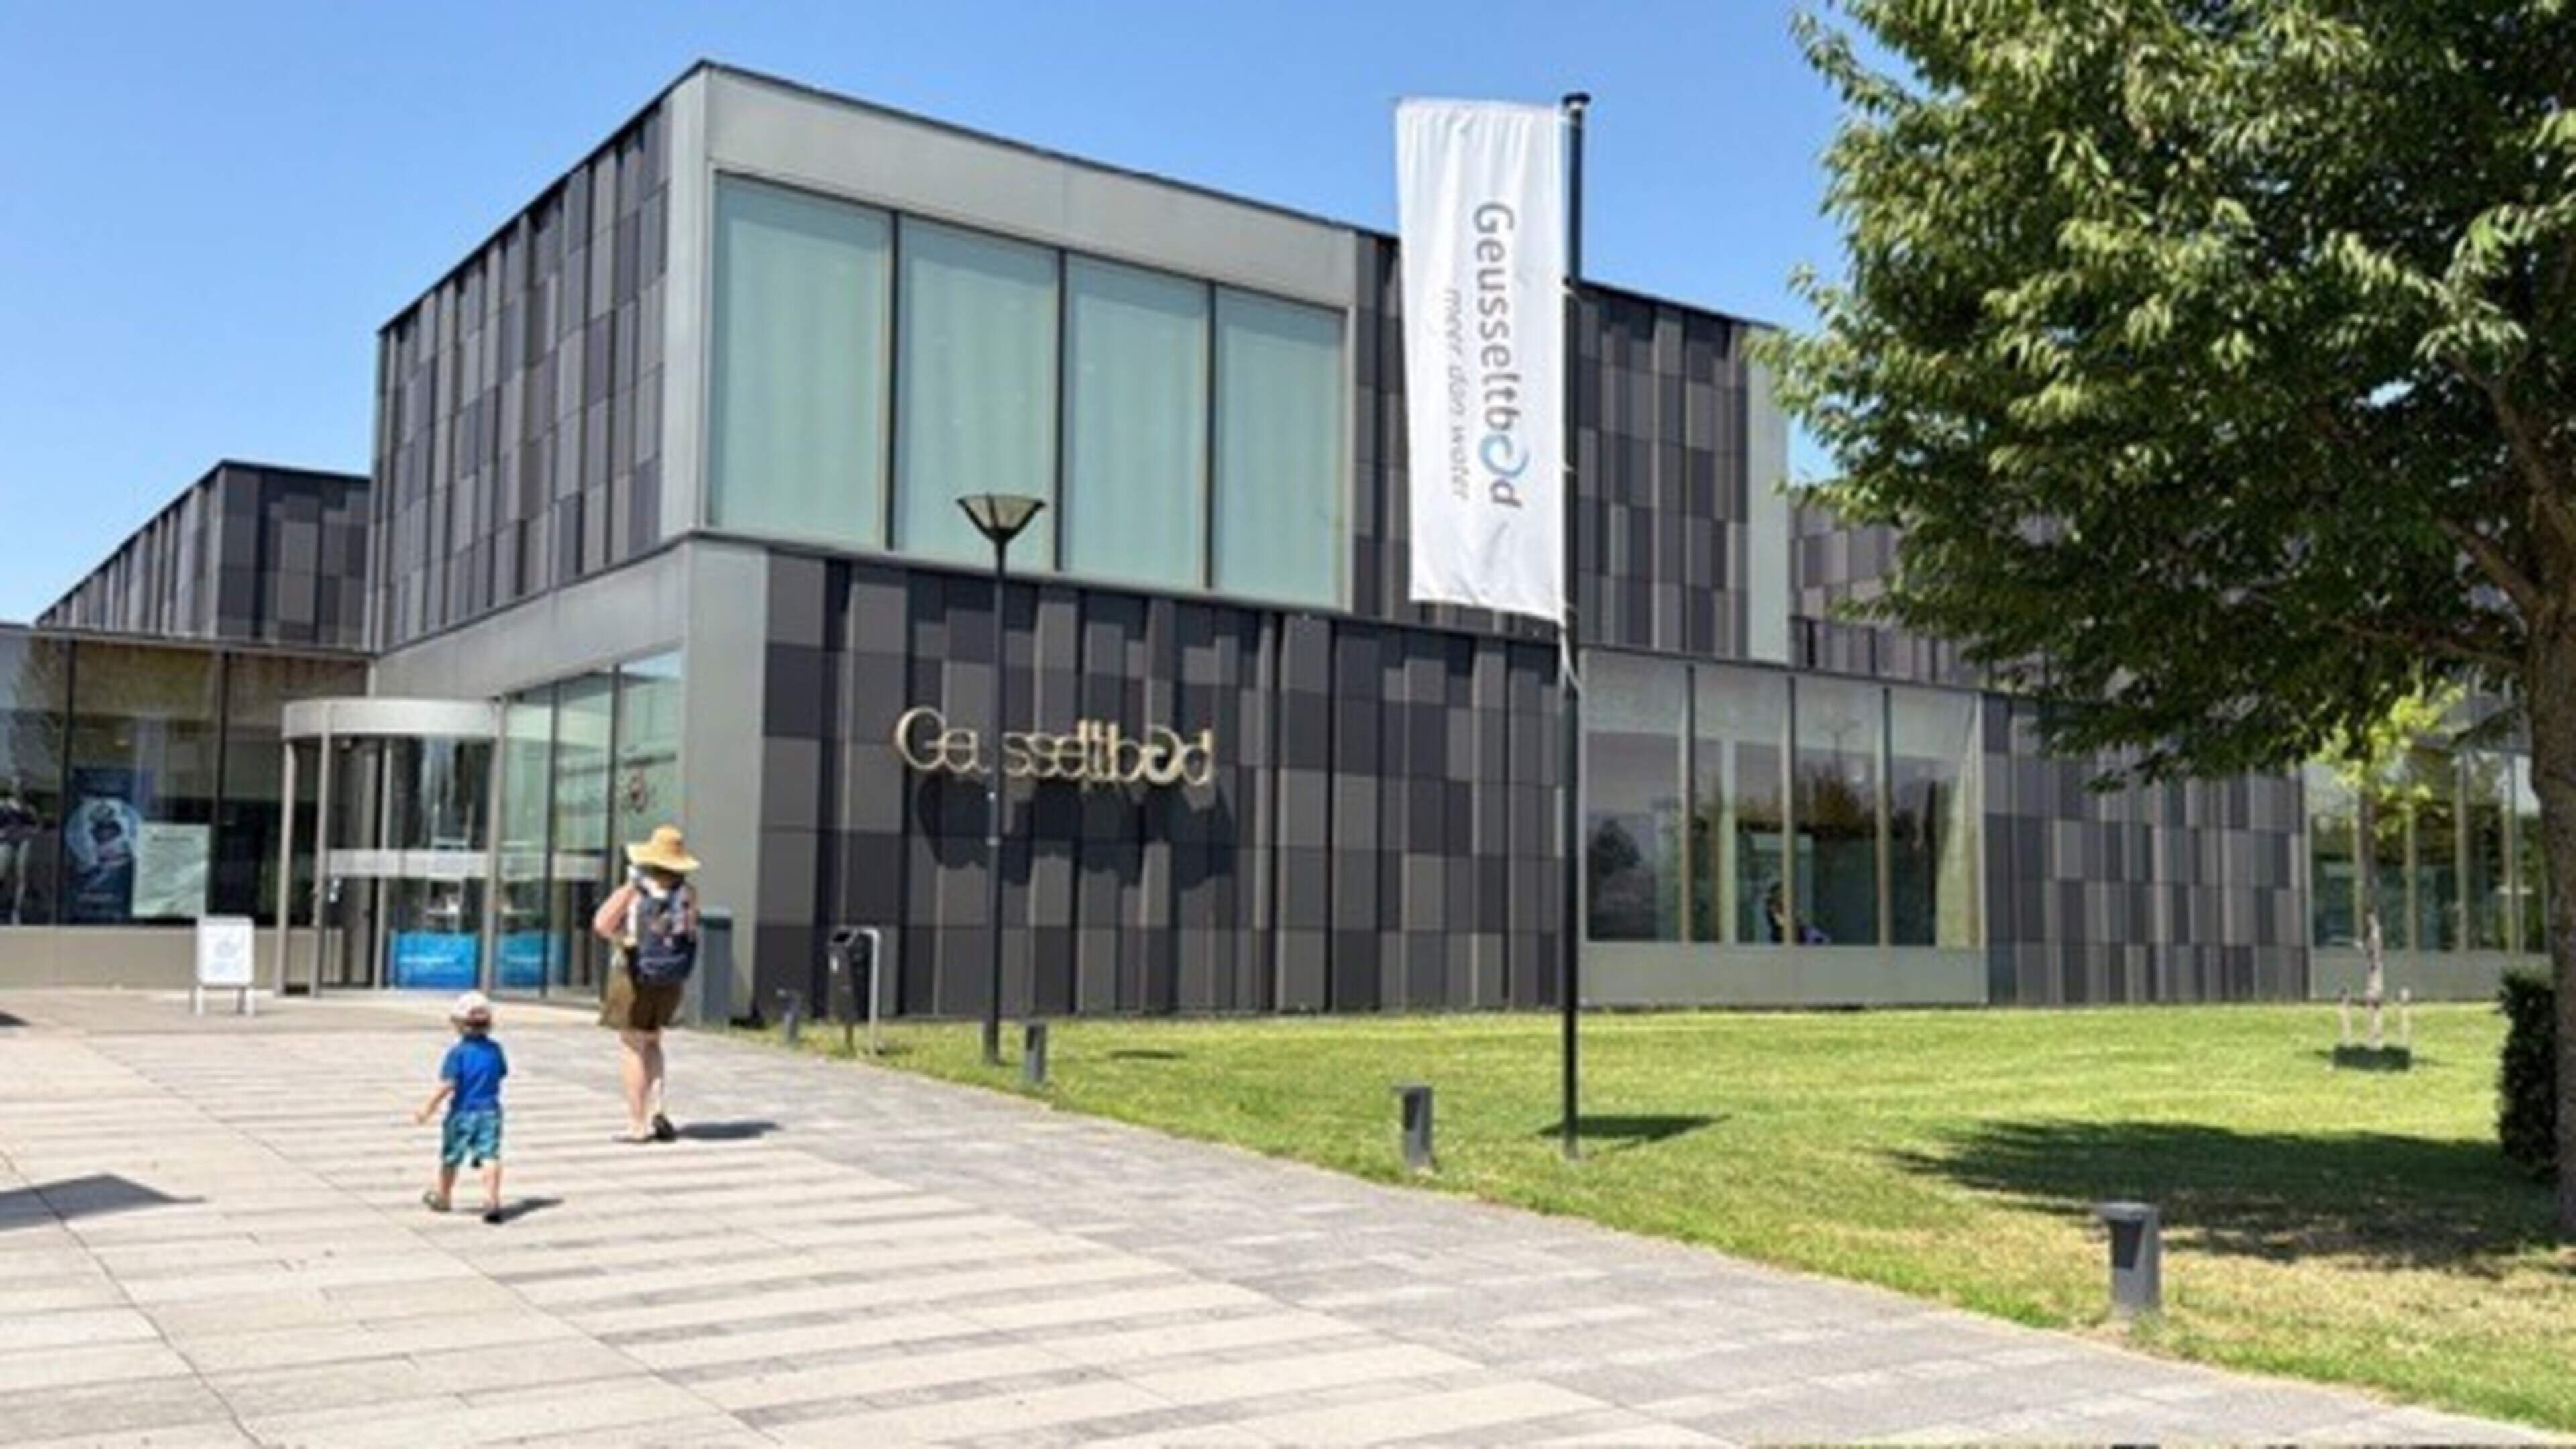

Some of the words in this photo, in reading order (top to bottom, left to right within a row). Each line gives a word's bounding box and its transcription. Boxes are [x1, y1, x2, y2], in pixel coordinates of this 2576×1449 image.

[1444, 288, 1464, 356] meer
[1473, 202, 1530, 509] Geusseltbad
[1448, 366, 1469, 416] dan
[1451, 425, 1470, 500] water
